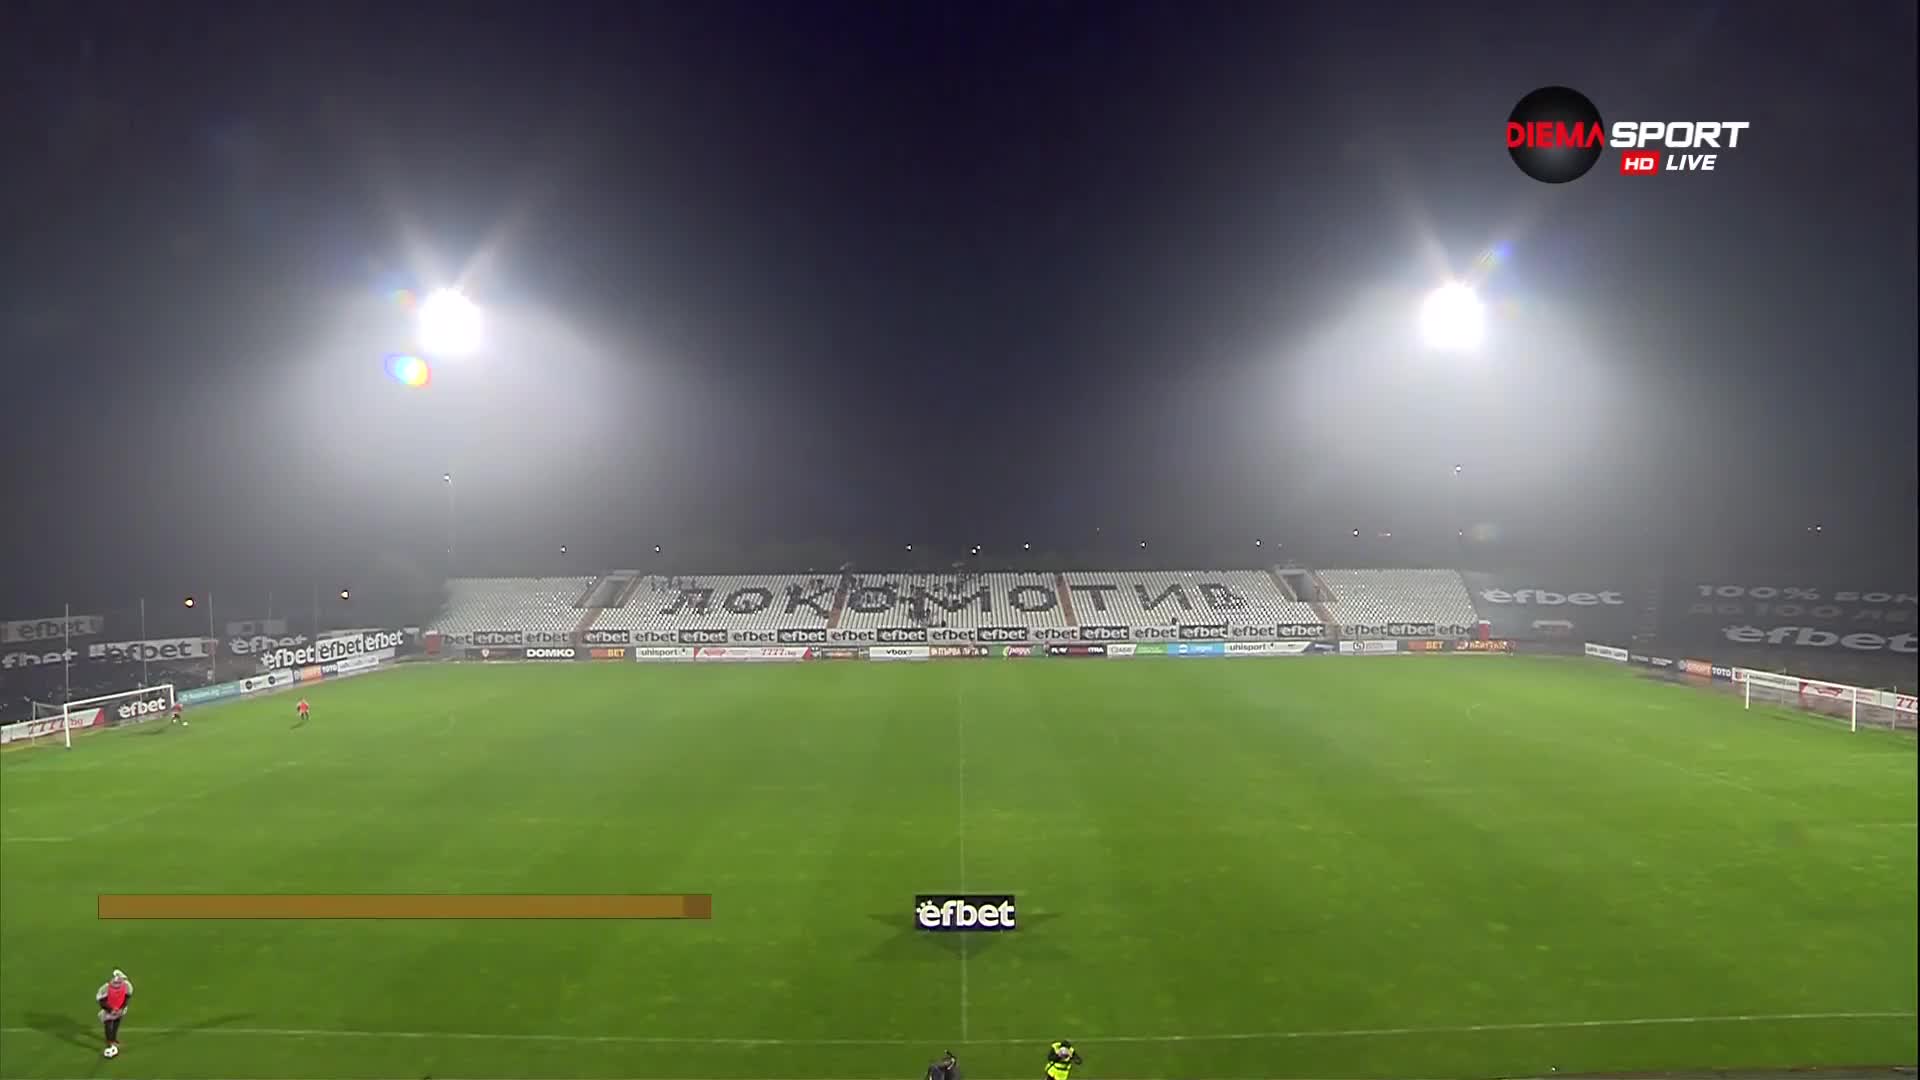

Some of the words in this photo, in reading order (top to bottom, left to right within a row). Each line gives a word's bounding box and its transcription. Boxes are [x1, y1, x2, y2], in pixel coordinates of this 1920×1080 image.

[1480, 588, 1625, 605] efbet
[1697, 584, 1821, 600] 100%
[932, 629, 976, 641] efbet
[982, 628, 1026, 639] efbet
[1034, 628, 1077, 640] efbet
[1084, 627, 1127, 639] efbet
[1135, 627, 1176, 638] efbet
[1181, 626, 1226, 638] efbet
[1232, 625, 1274, 636] efbet
[1280, 625, 1324, 636] efbet
[1345, 624, 1386, 635] efbet
[1391, 623, 1434, 635] efbet
[365, 630, 403, 650] efbet
[478, 632, 521, 643] efbet
[526, 631, 568, 642] efbet
[585, 631, 628, 643] efbet
[635, 631, 677, 641] efbet
[683, 630, 726, 642] efbet
[733, 630, 775, 641] efbet
[782, 630, 825, 641] efbet
[832, 630, 875, 641] efbet
[881, 630, 925, 641] efbet
[320, 639, 362, 659] efbet
[527, 648, 575, 657] DOMKO
[261, 645, 316, 669] efbet
[118, 697, 166, 718] efbet
[916, 900, 1015, 927] efbet
